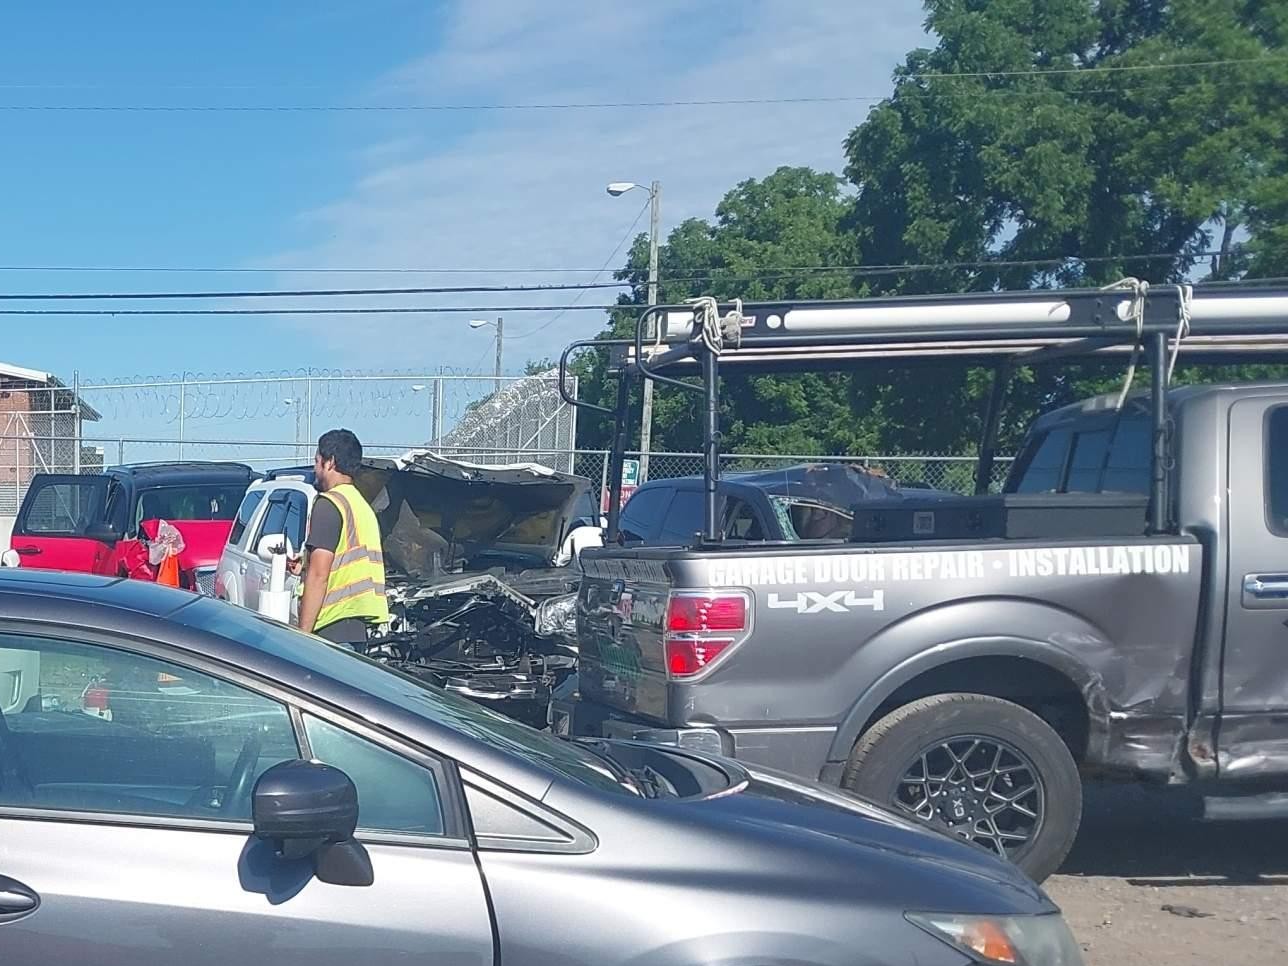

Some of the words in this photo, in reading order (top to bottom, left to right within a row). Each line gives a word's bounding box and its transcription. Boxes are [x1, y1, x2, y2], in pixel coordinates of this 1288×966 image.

[708, 557, 808, 587] GARAGE
[814, 554, 886, 584] DOOR
[892, 551, 985, 581] REPAIR
[1009, 544, 1190, 577] INSTALLATION
[767, 589, 885, 614] 4X4
